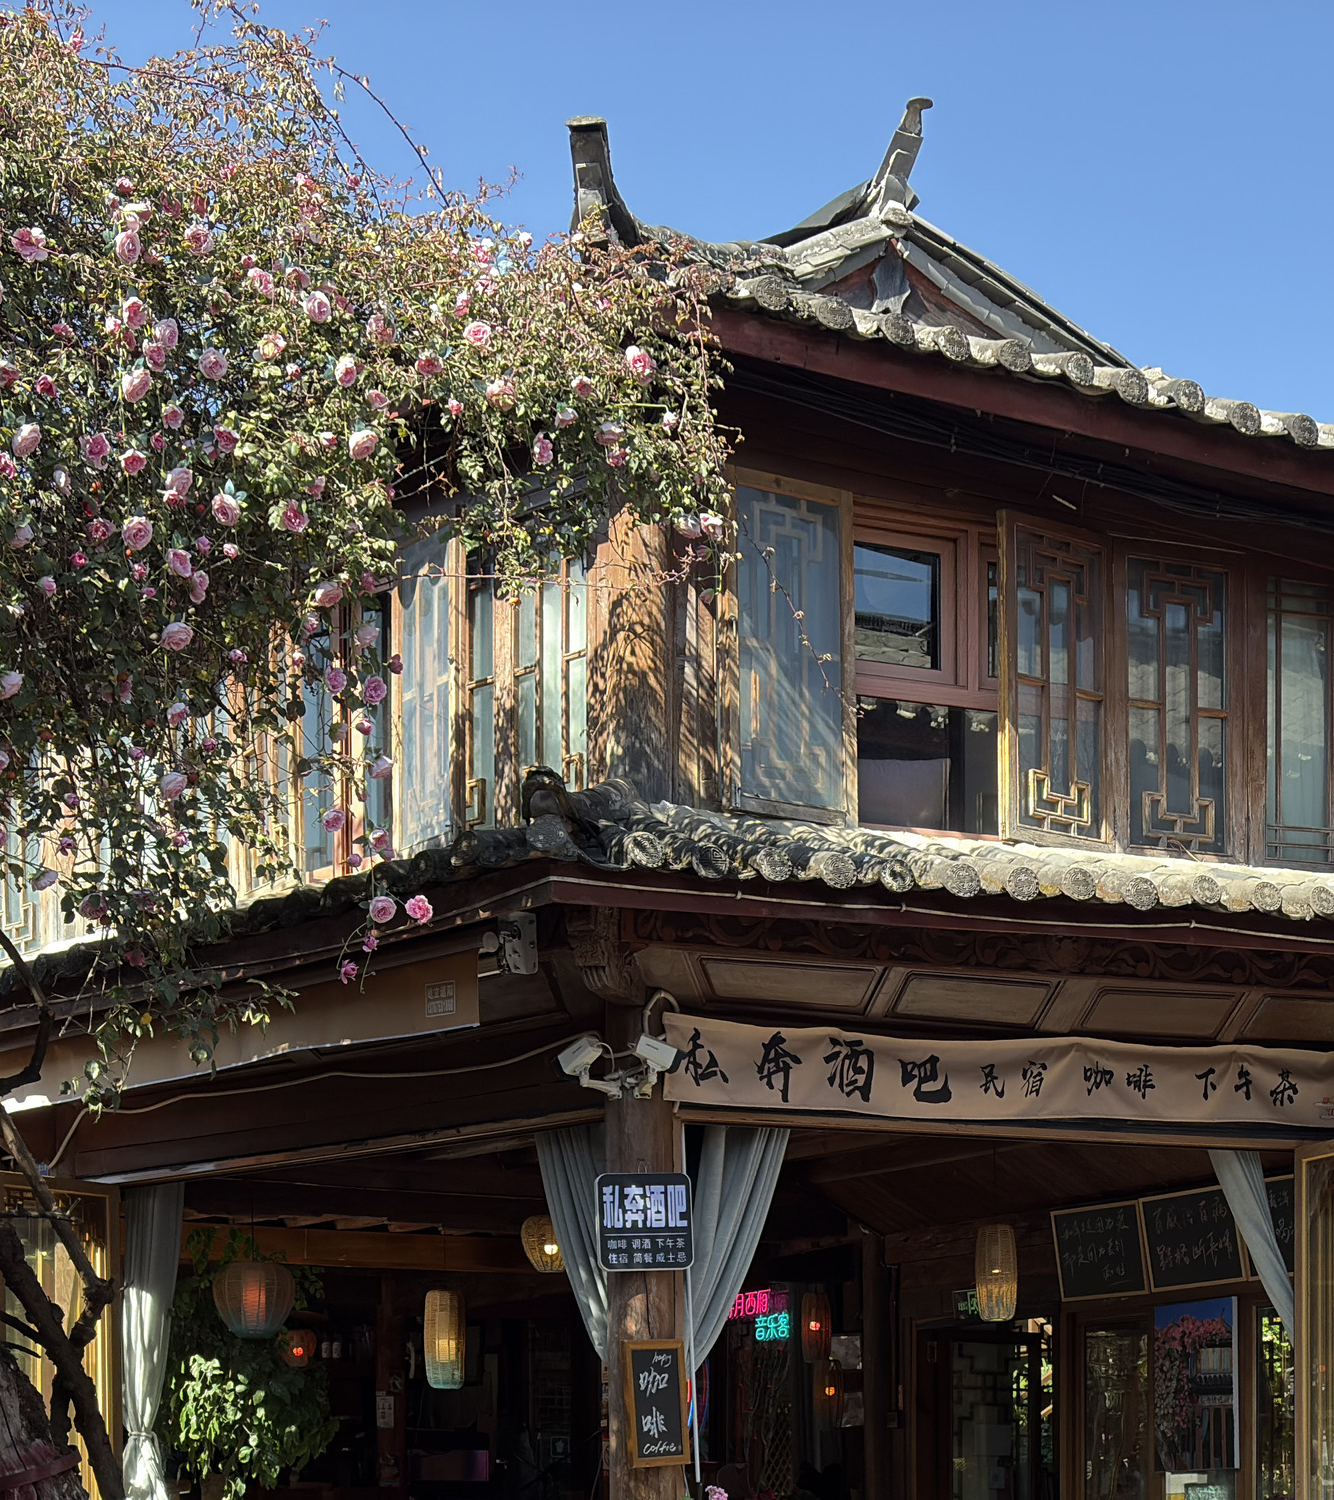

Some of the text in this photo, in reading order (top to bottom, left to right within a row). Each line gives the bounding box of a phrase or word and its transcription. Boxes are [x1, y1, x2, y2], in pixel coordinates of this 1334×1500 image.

[681, 1027, 1299, 1106] 私奔酒吧 民宿 咖啡 下午茶
[602, 1184, 688, 1228] 私奔酒吧
[607, 1237, 685, 1250] 咖啡 调酒 下午茶
[608, 1251, 687, 1264] 住宿 简餐 威士忌
